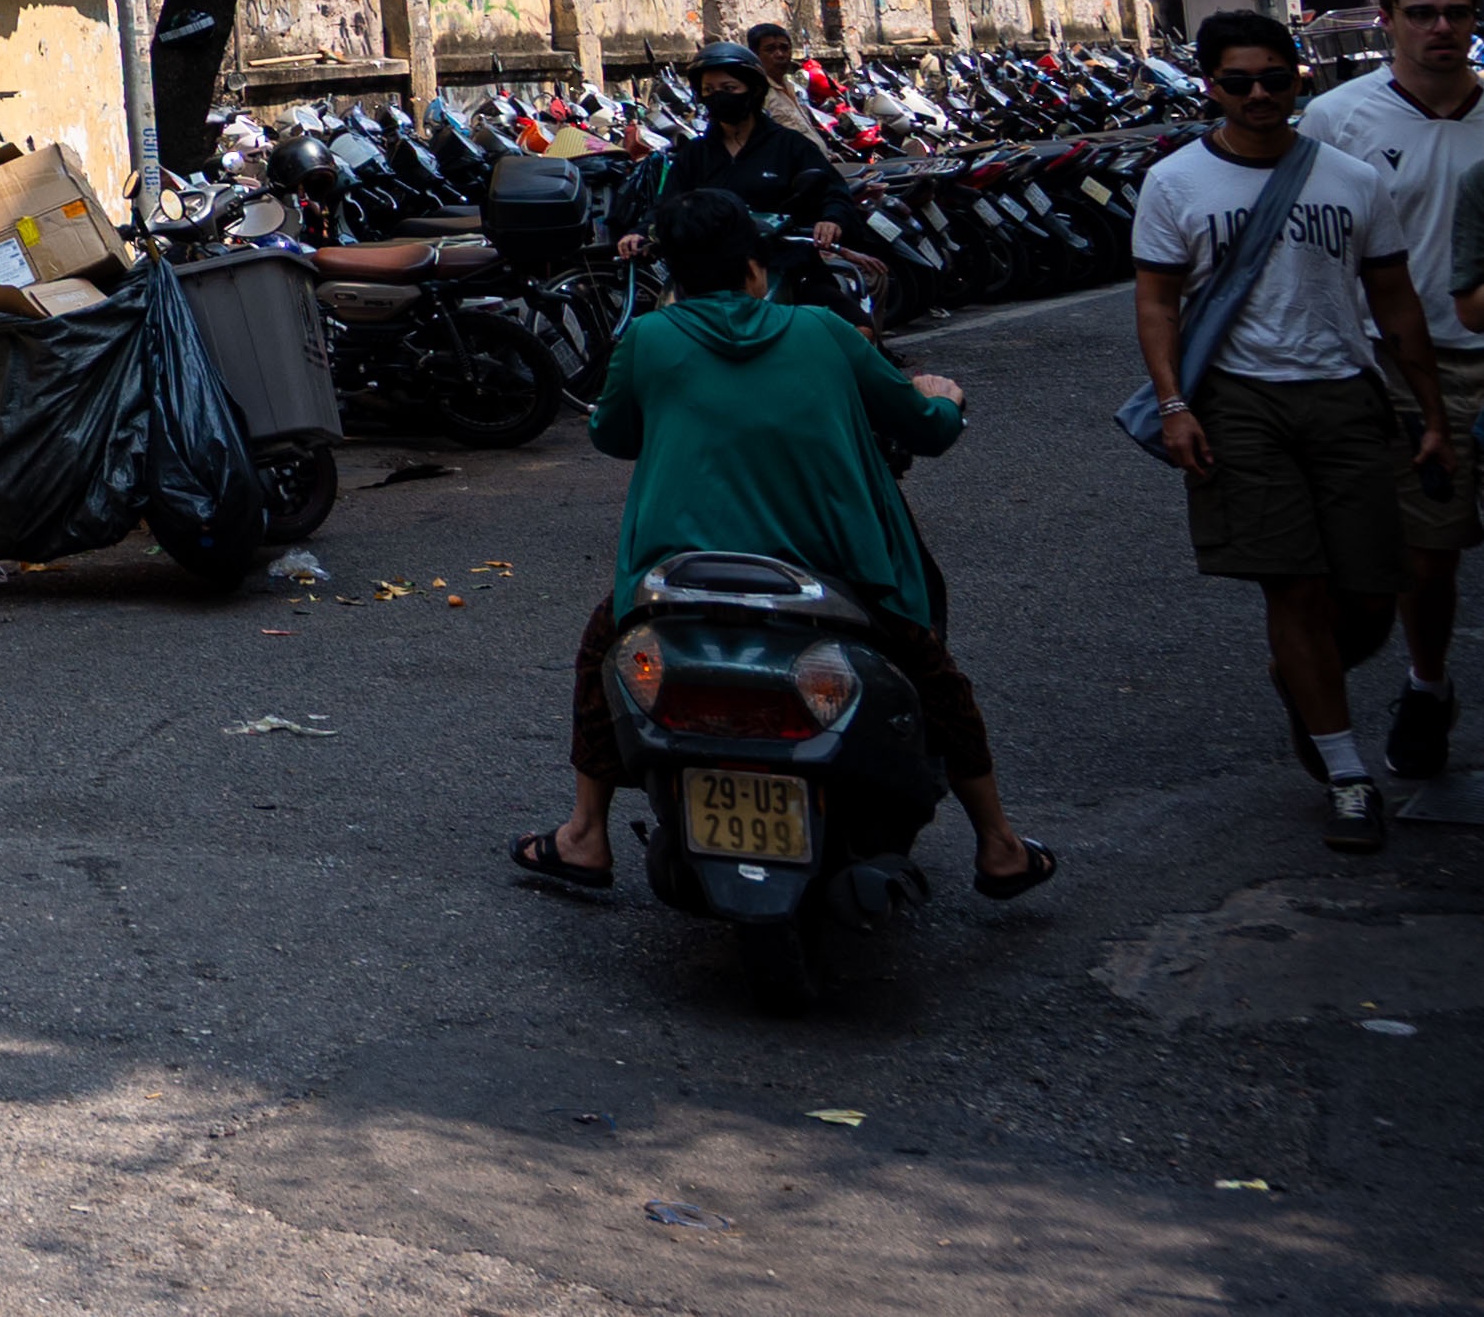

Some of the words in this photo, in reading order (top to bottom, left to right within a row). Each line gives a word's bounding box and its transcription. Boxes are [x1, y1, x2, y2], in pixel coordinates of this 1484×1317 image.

[1208, 204, 1353, 266] WOSHOP
[703, 774, 788, 815] 29-U3
[704, 813, 791, 854] 2999
